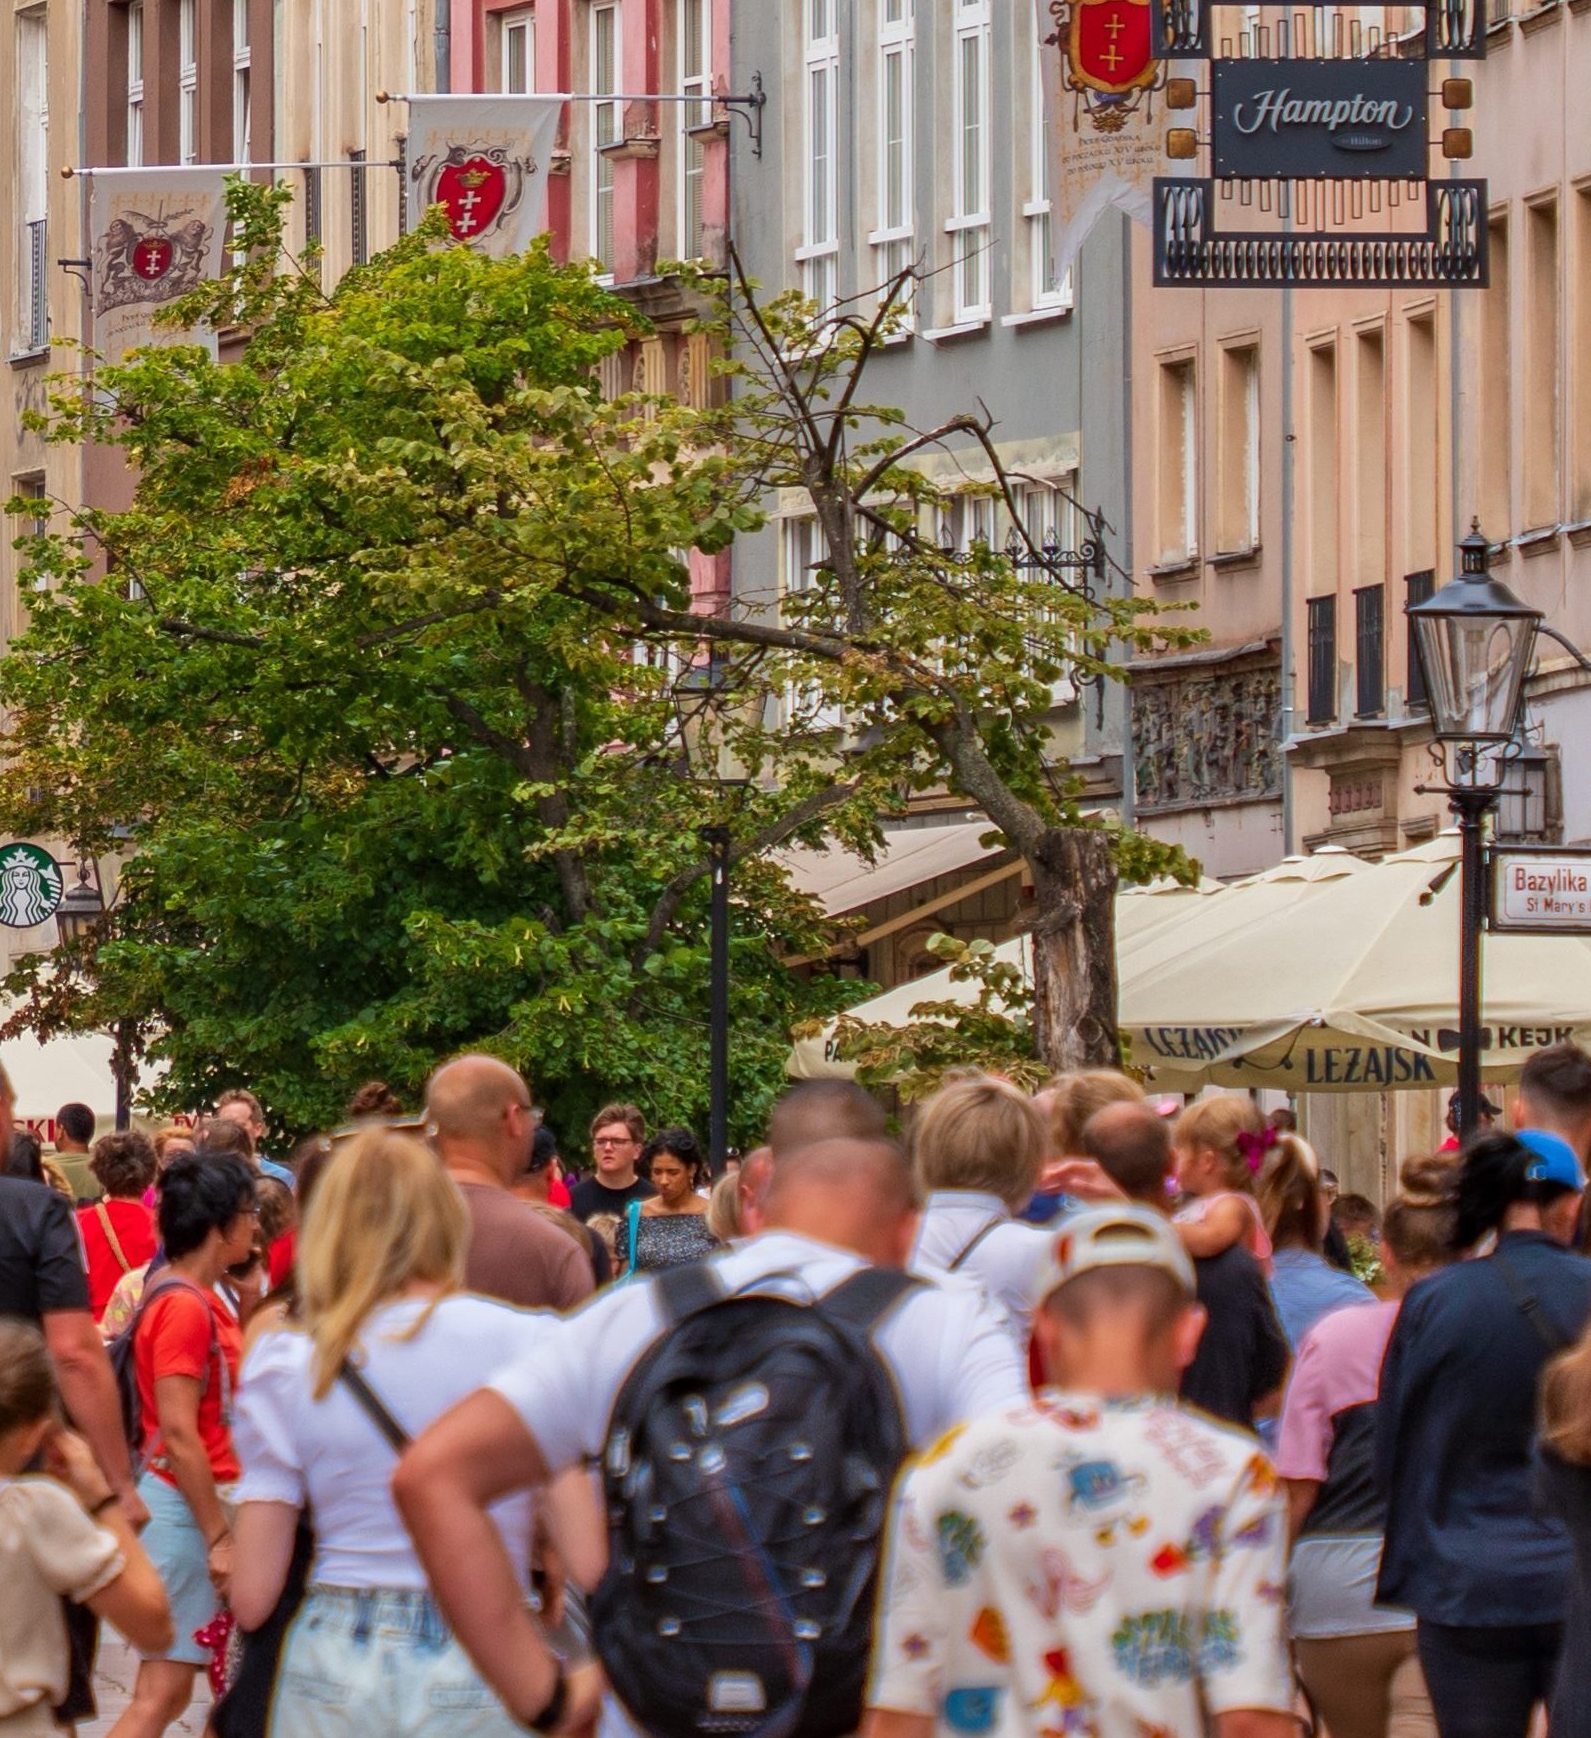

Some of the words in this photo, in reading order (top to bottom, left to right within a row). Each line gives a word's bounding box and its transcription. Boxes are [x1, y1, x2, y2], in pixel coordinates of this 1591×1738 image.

[1234, 87, 1413, 134] Hampton
[1515, 867, 1588, 895] Bazylika
[1527, 897, 1539, 913] St
[1306, 1046, 1437, 1086] LEŻAJSK
